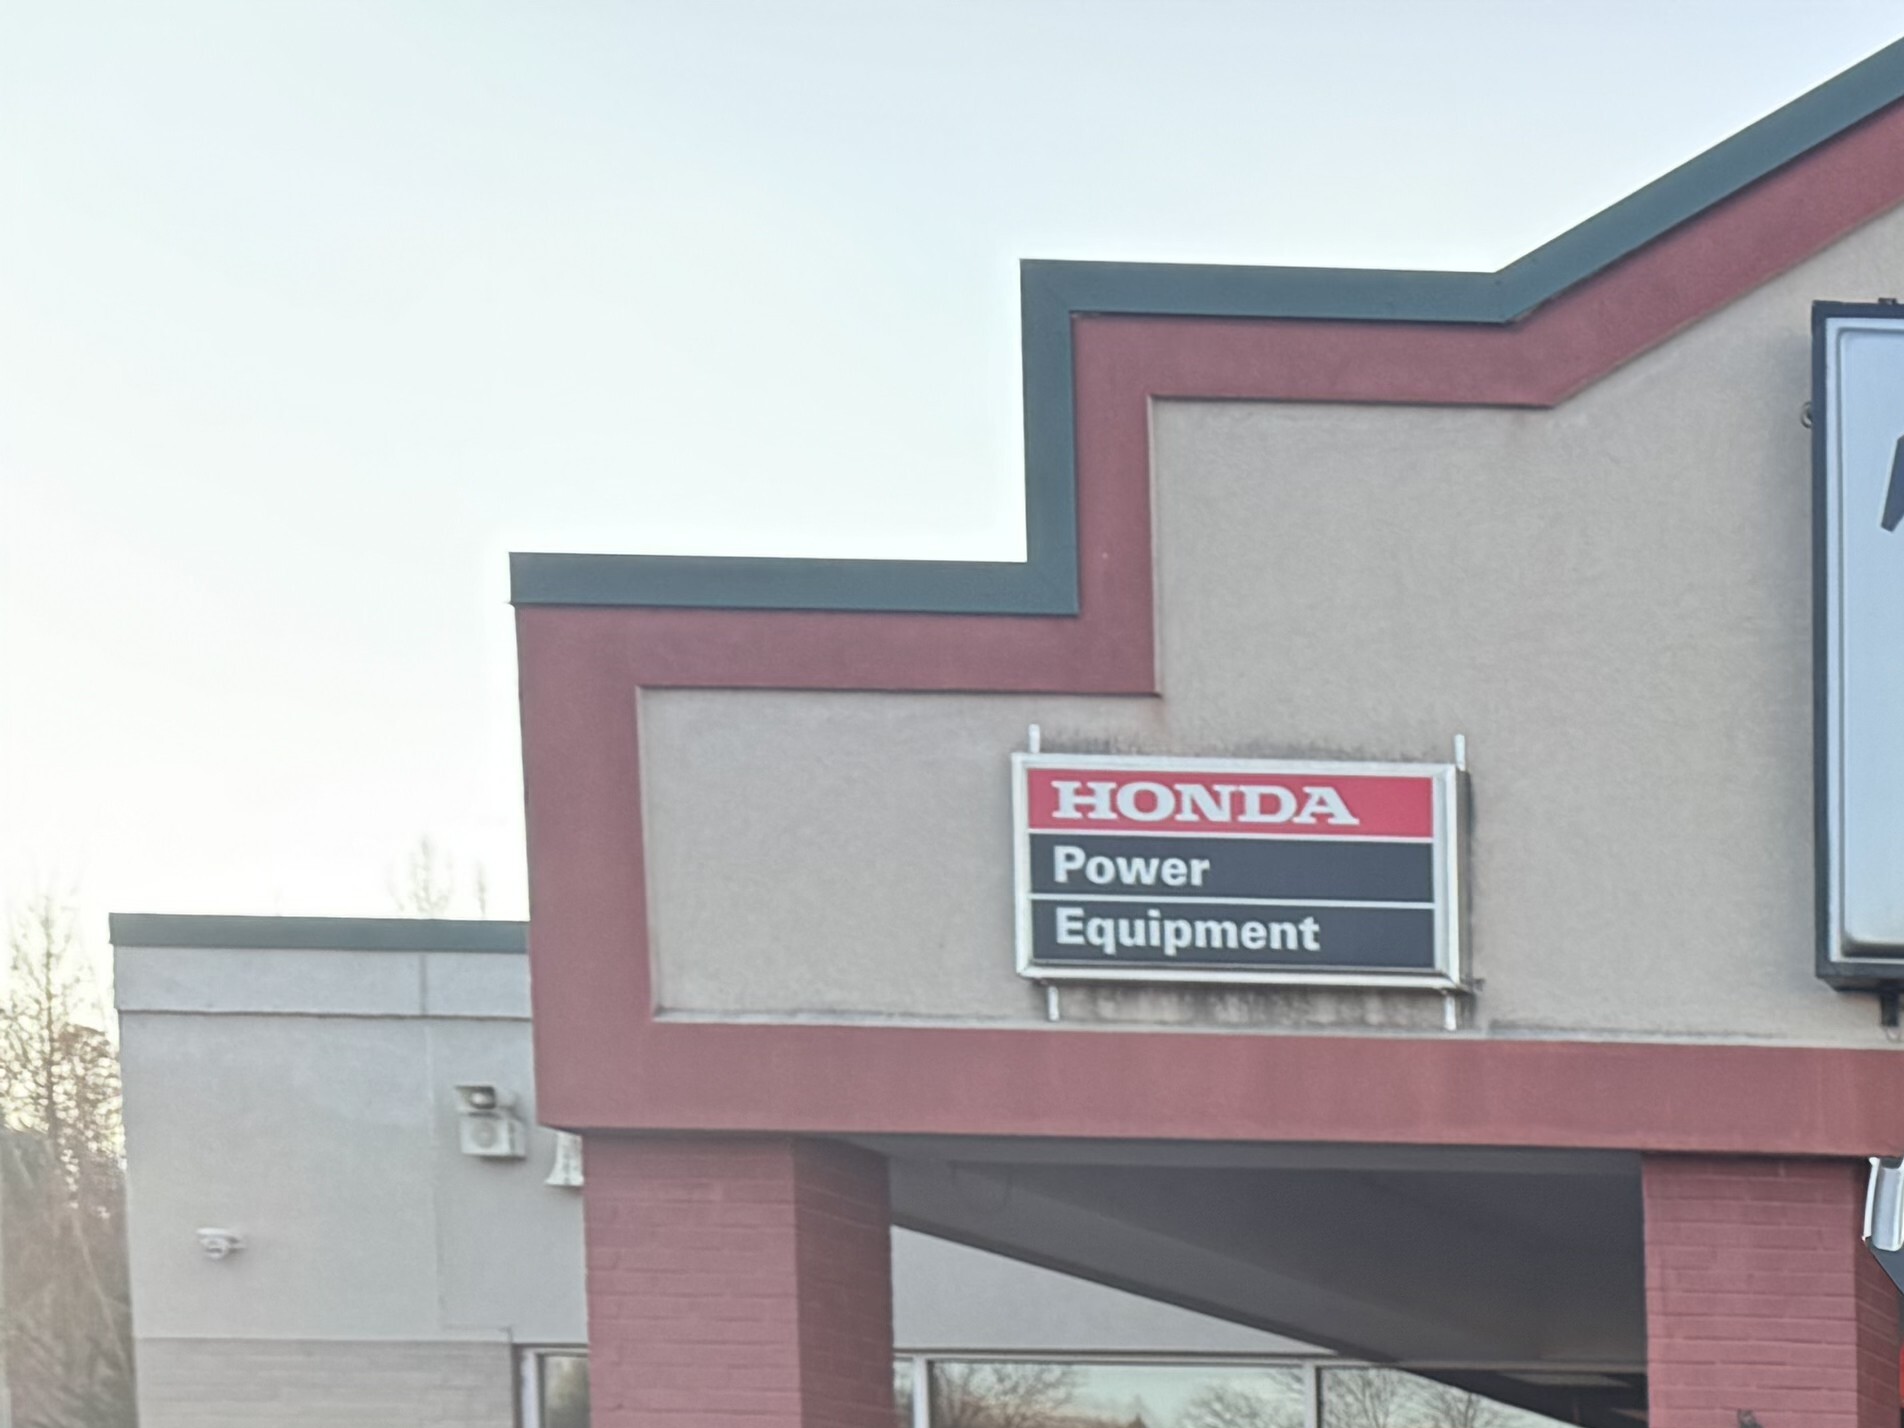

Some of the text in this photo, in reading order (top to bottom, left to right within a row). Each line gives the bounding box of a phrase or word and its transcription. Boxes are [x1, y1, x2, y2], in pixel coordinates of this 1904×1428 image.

[1051, 779, 1360, 826] HONDA
[1053, 844, 1211, 888] Power
[1055, 906, 1321, 957] Equipment
